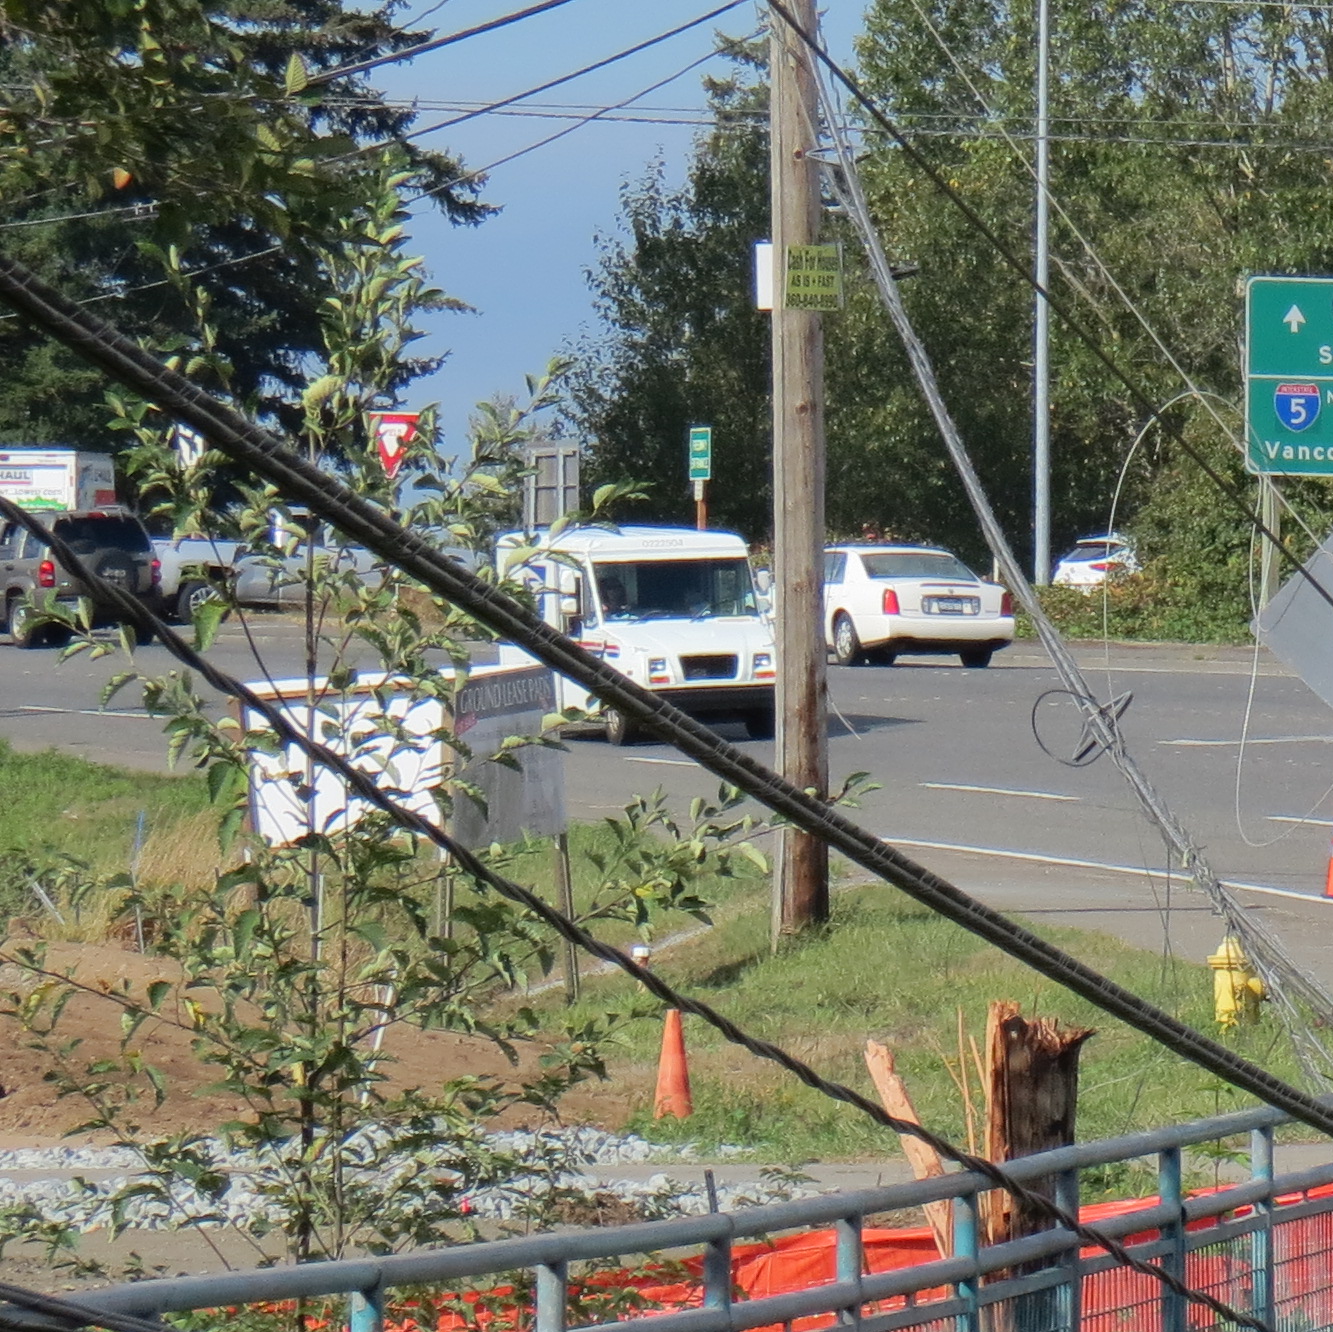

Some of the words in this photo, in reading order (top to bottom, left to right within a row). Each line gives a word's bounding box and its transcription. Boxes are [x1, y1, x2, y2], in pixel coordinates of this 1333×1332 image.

[1290, 398, 1307, 425] 5
[461, 683, 501, 714] GROUND
[503, 679, 528, 706] LEASE
